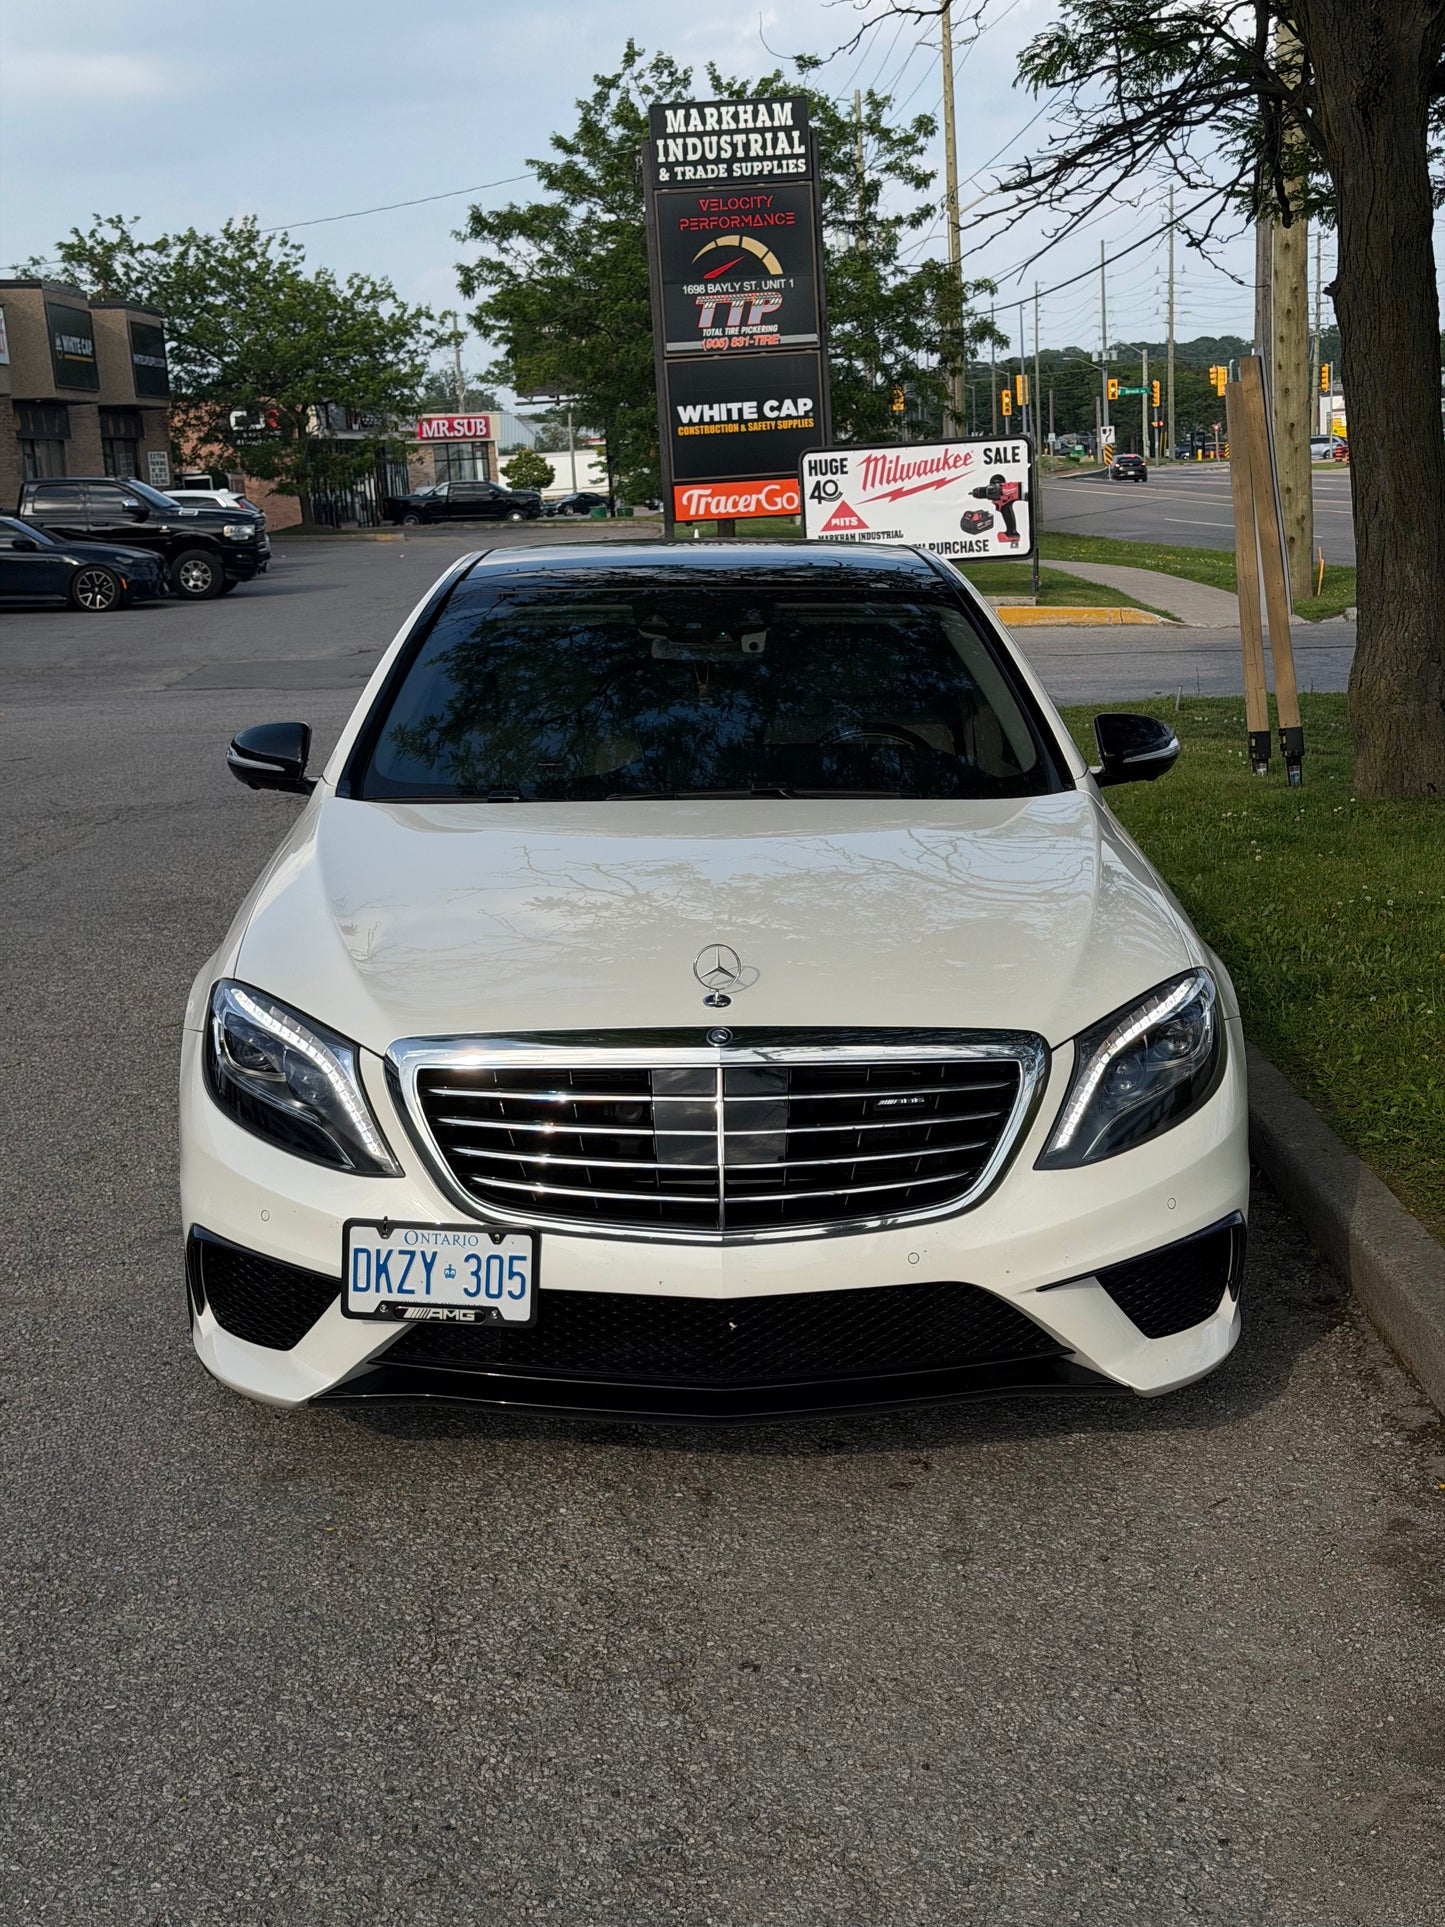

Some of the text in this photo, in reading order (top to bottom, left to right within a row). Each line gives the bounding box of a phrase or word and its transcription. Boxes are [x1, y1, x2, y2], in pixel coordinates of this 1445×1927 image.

[665, 102, 793, 134] MARKHAM
[656, 130, 806, 163] INDUSTRIAL
[658, 158, 807, 182] & TRADE SUPPLIES
[698, 195, 774, 212] VELOCITY
[679, 212, 796, 231] PERFORMANCE
[682, 278, 795, 295] 1698 BAYLY ST. UNIT 1
[702, 324, 779, 337] TOTAL TIRE PICKERING
[676, 398, 814, 424] WHITE CAP
[677, 418, 815, 437] CONSTRUCTION & SAFETY SUPPLIES
[808, 445, 1021, 492] HUGE Milwaukee SALE
[681, 485, 799, 516] TracerGo
[858, 530, 904, 542] INDUSTRIAL
[404, 1230, 479, 1248] ONTARIO
[352, 1247, 527, 1300] DKZY 305
